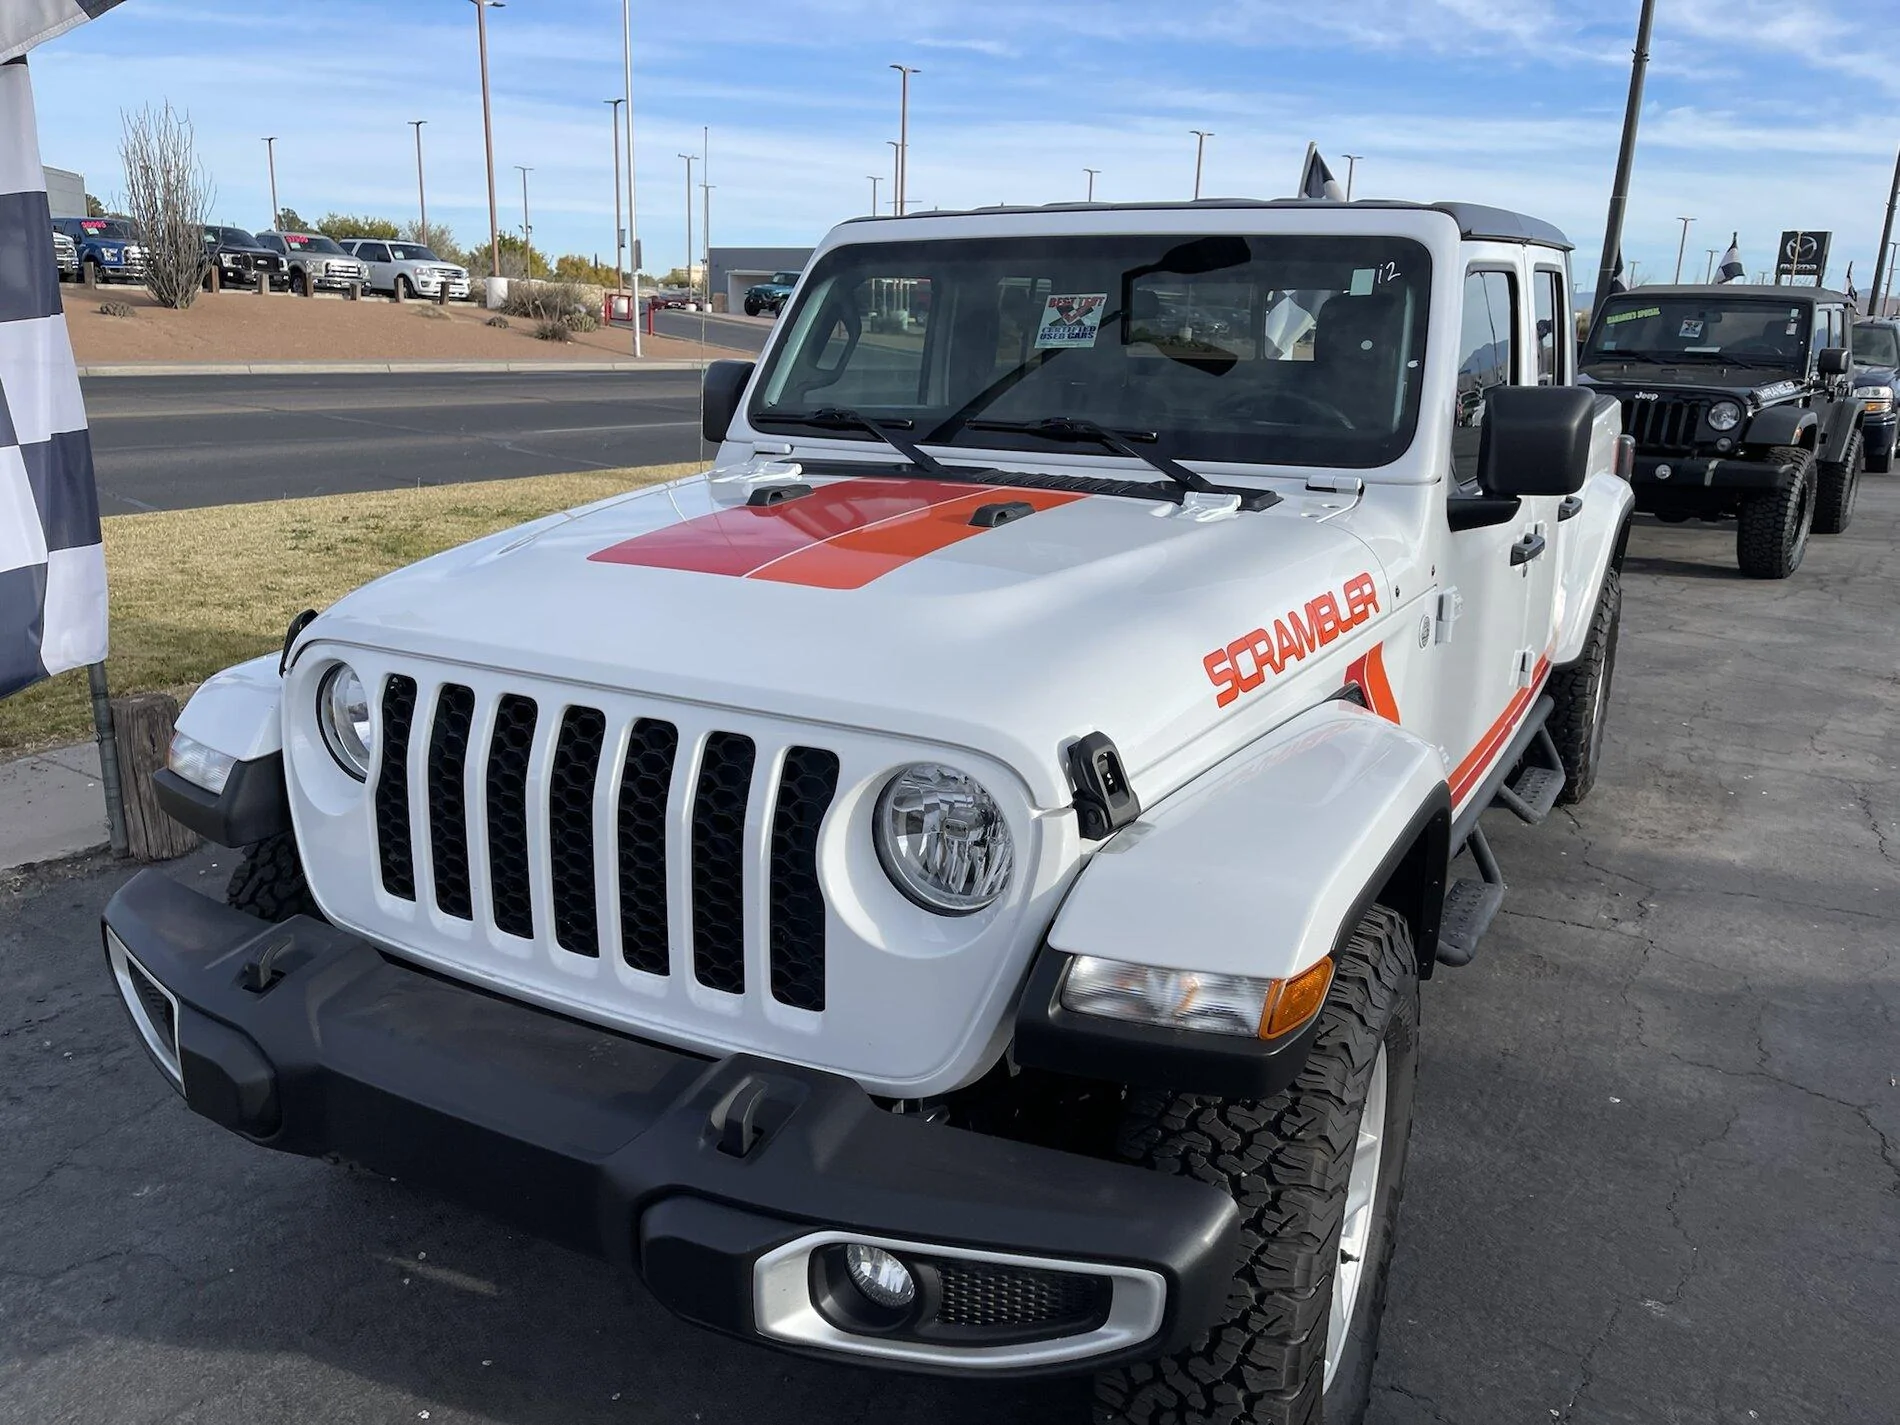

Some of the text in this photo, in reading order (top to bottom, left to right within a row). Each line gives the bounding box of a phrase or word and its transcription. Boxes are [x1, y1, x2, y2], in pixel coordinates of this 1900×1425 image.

[1041, 326, 1097, 334] CERTIFIED
[1067, 332, 1095, 340] CARS
[1634, 391, 1659, 401] Jeep
[1755, 381, 1797, 401] WRANGLER
[1203, 572, 1380, 708] SCRAMBLER
